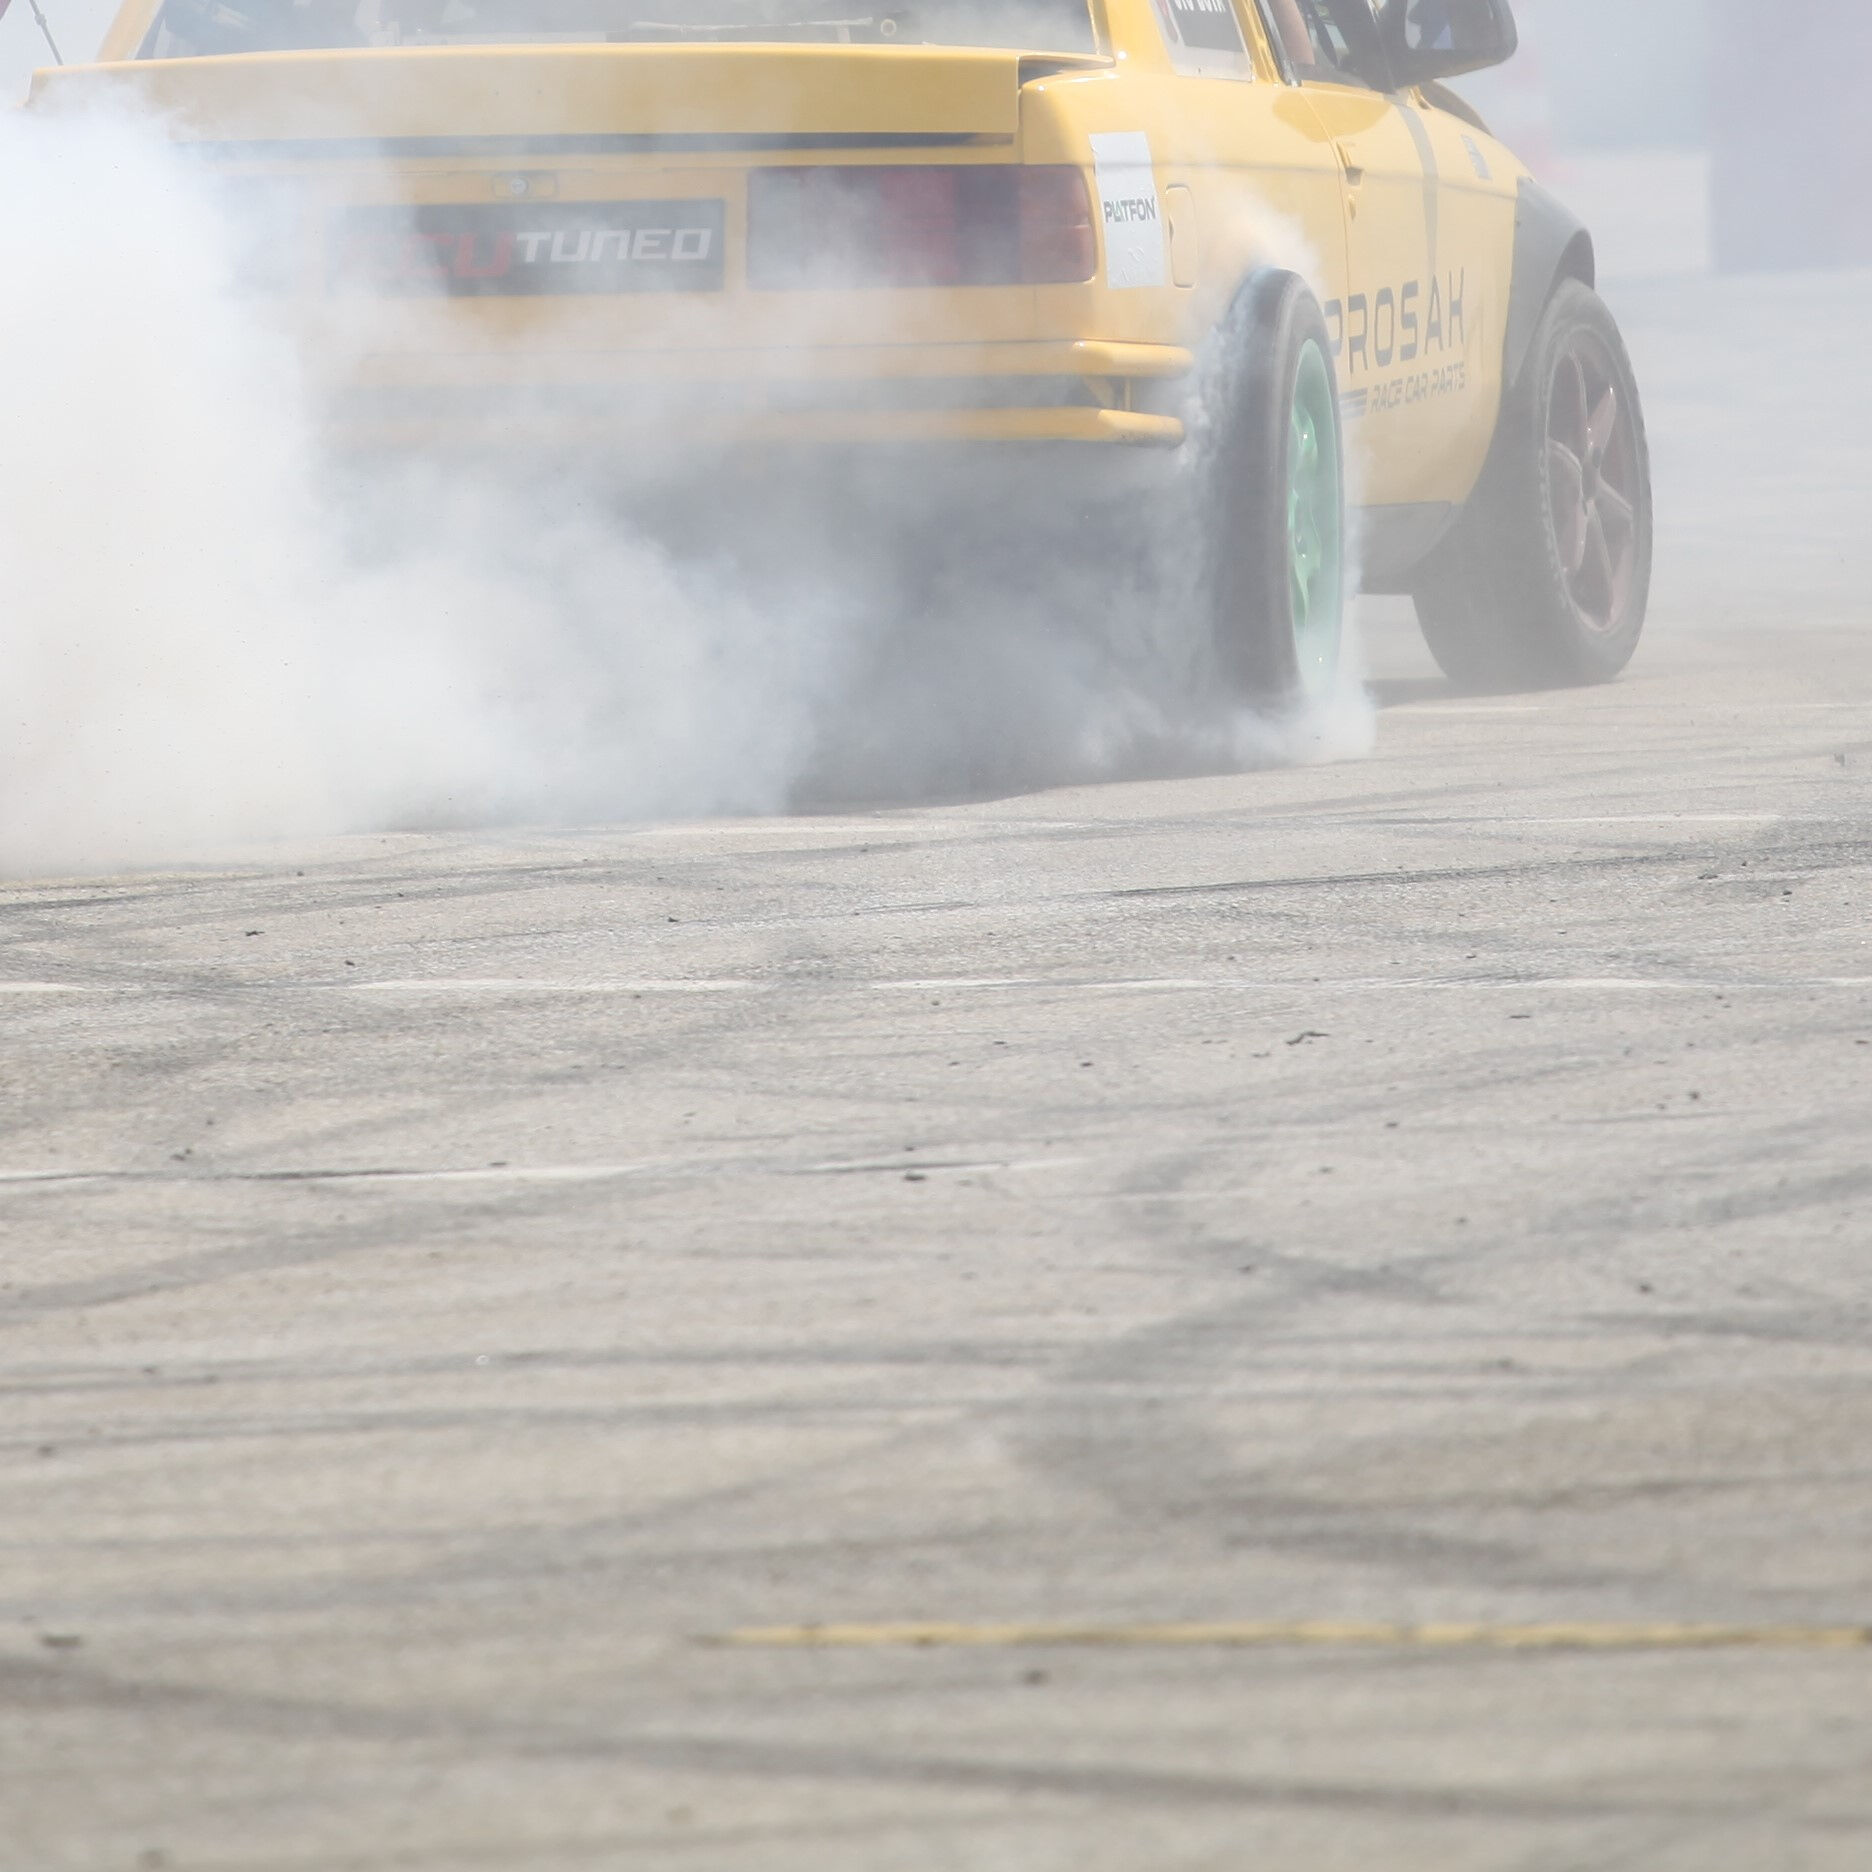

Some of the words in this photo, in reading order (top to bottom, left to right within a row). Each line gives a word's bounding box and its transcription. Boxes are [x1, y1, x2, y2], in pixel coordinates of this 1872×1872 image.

[1370, 378, 1404, 415] RACE
[1404, 370, 1429, 405] CAR
[1430, 360, 1466, 399] PARTS
